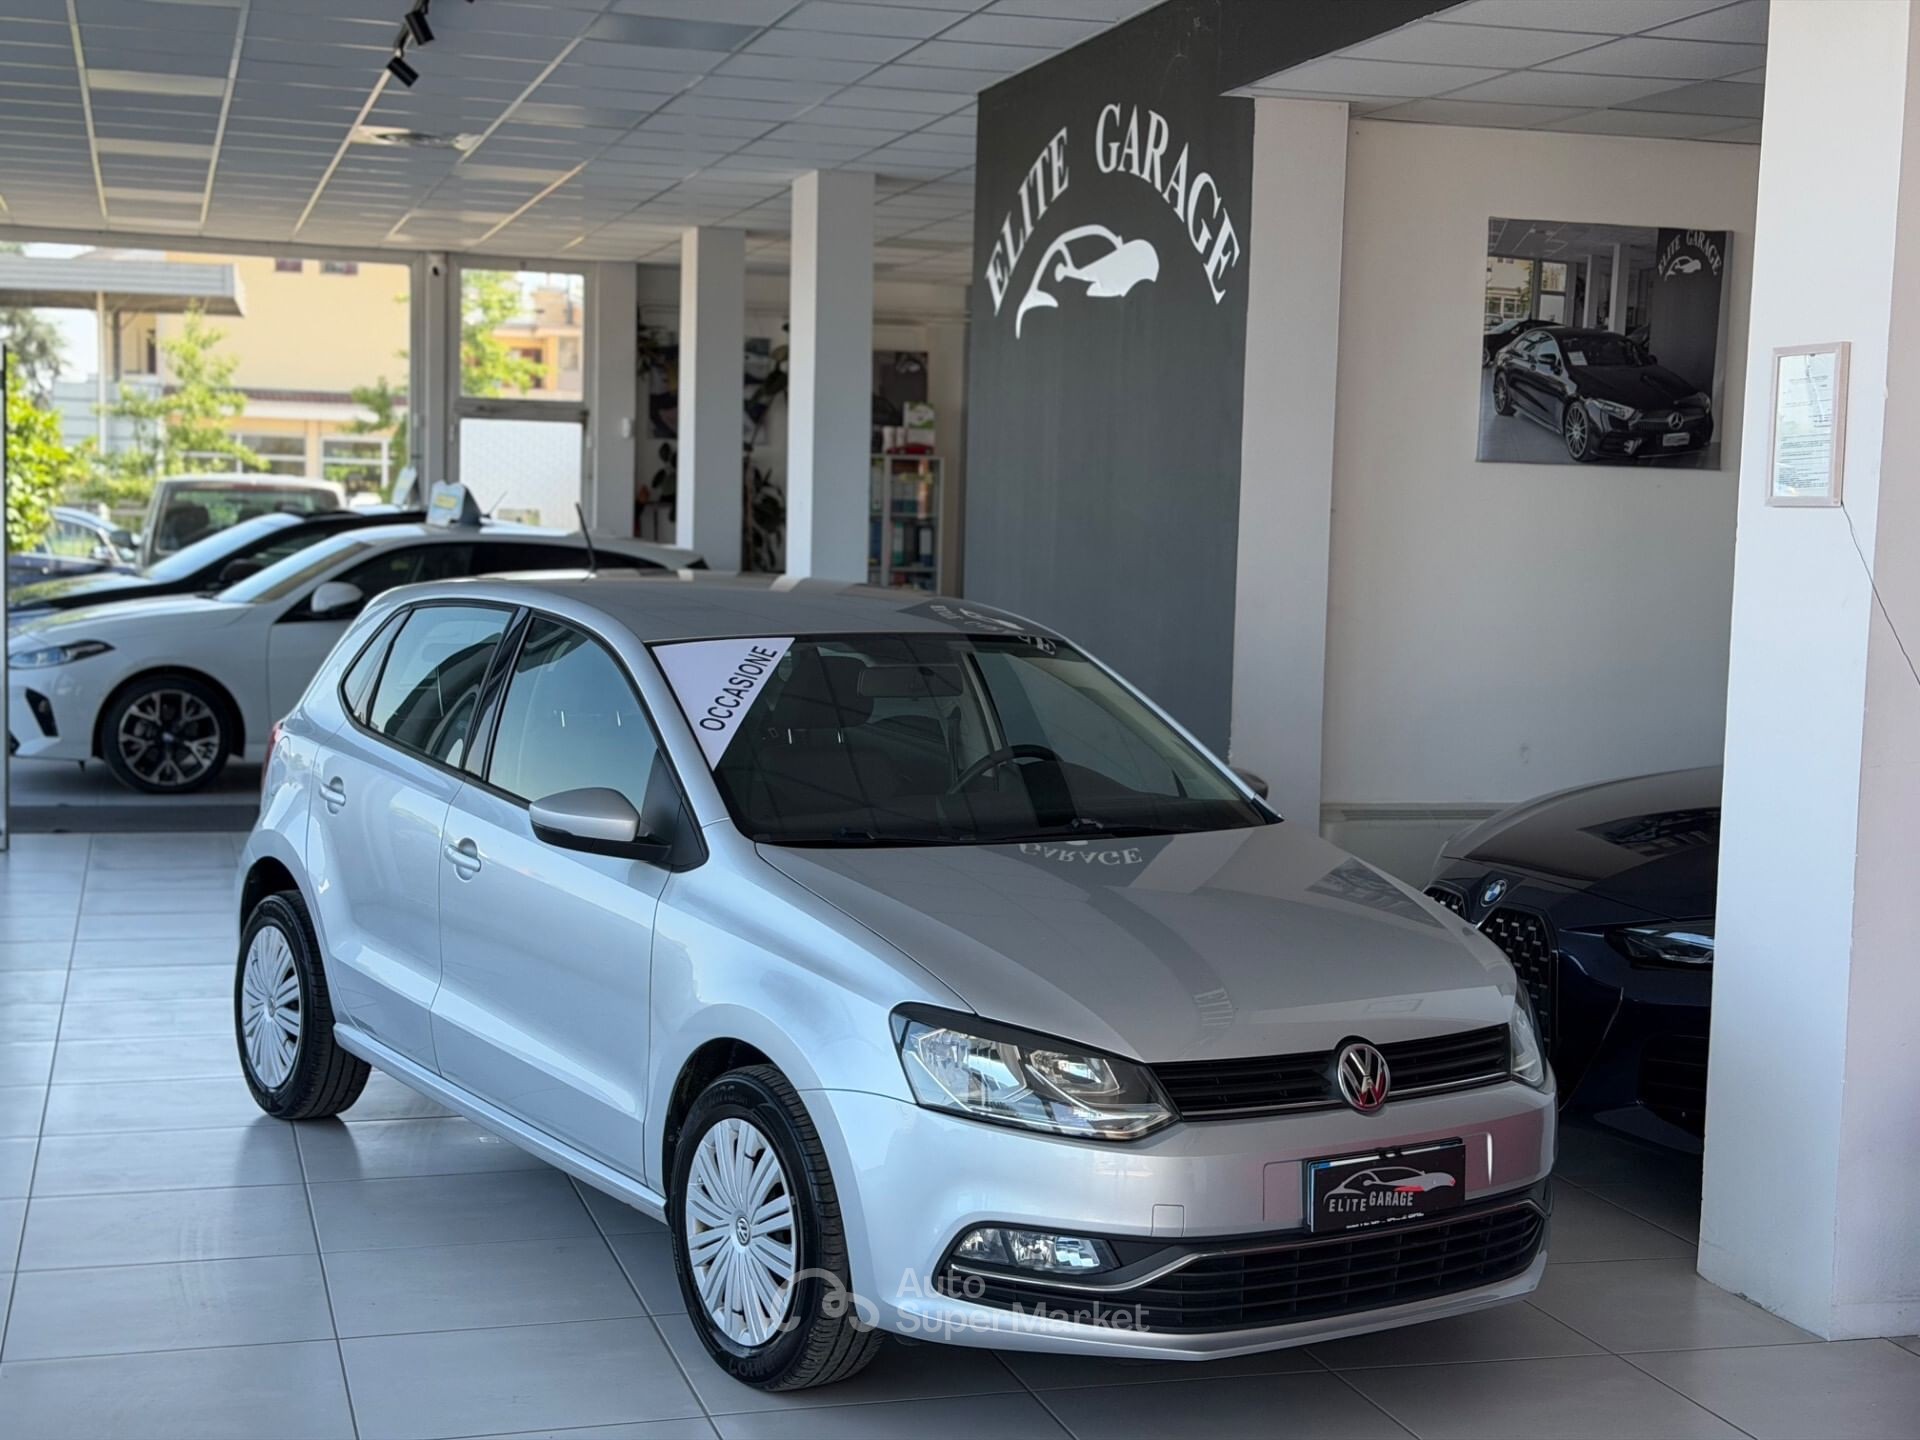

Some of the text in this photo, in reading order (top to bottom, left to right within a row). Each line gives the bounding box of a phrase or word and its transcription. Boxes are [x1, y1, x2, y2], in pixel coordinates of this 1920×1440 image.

[985, 103, 1240, 317] ELITE GARAGE
[699, 645, 778, 731] OCCASIONE
[1329, 1191, 1414, 1213] ELITE GARAGE
